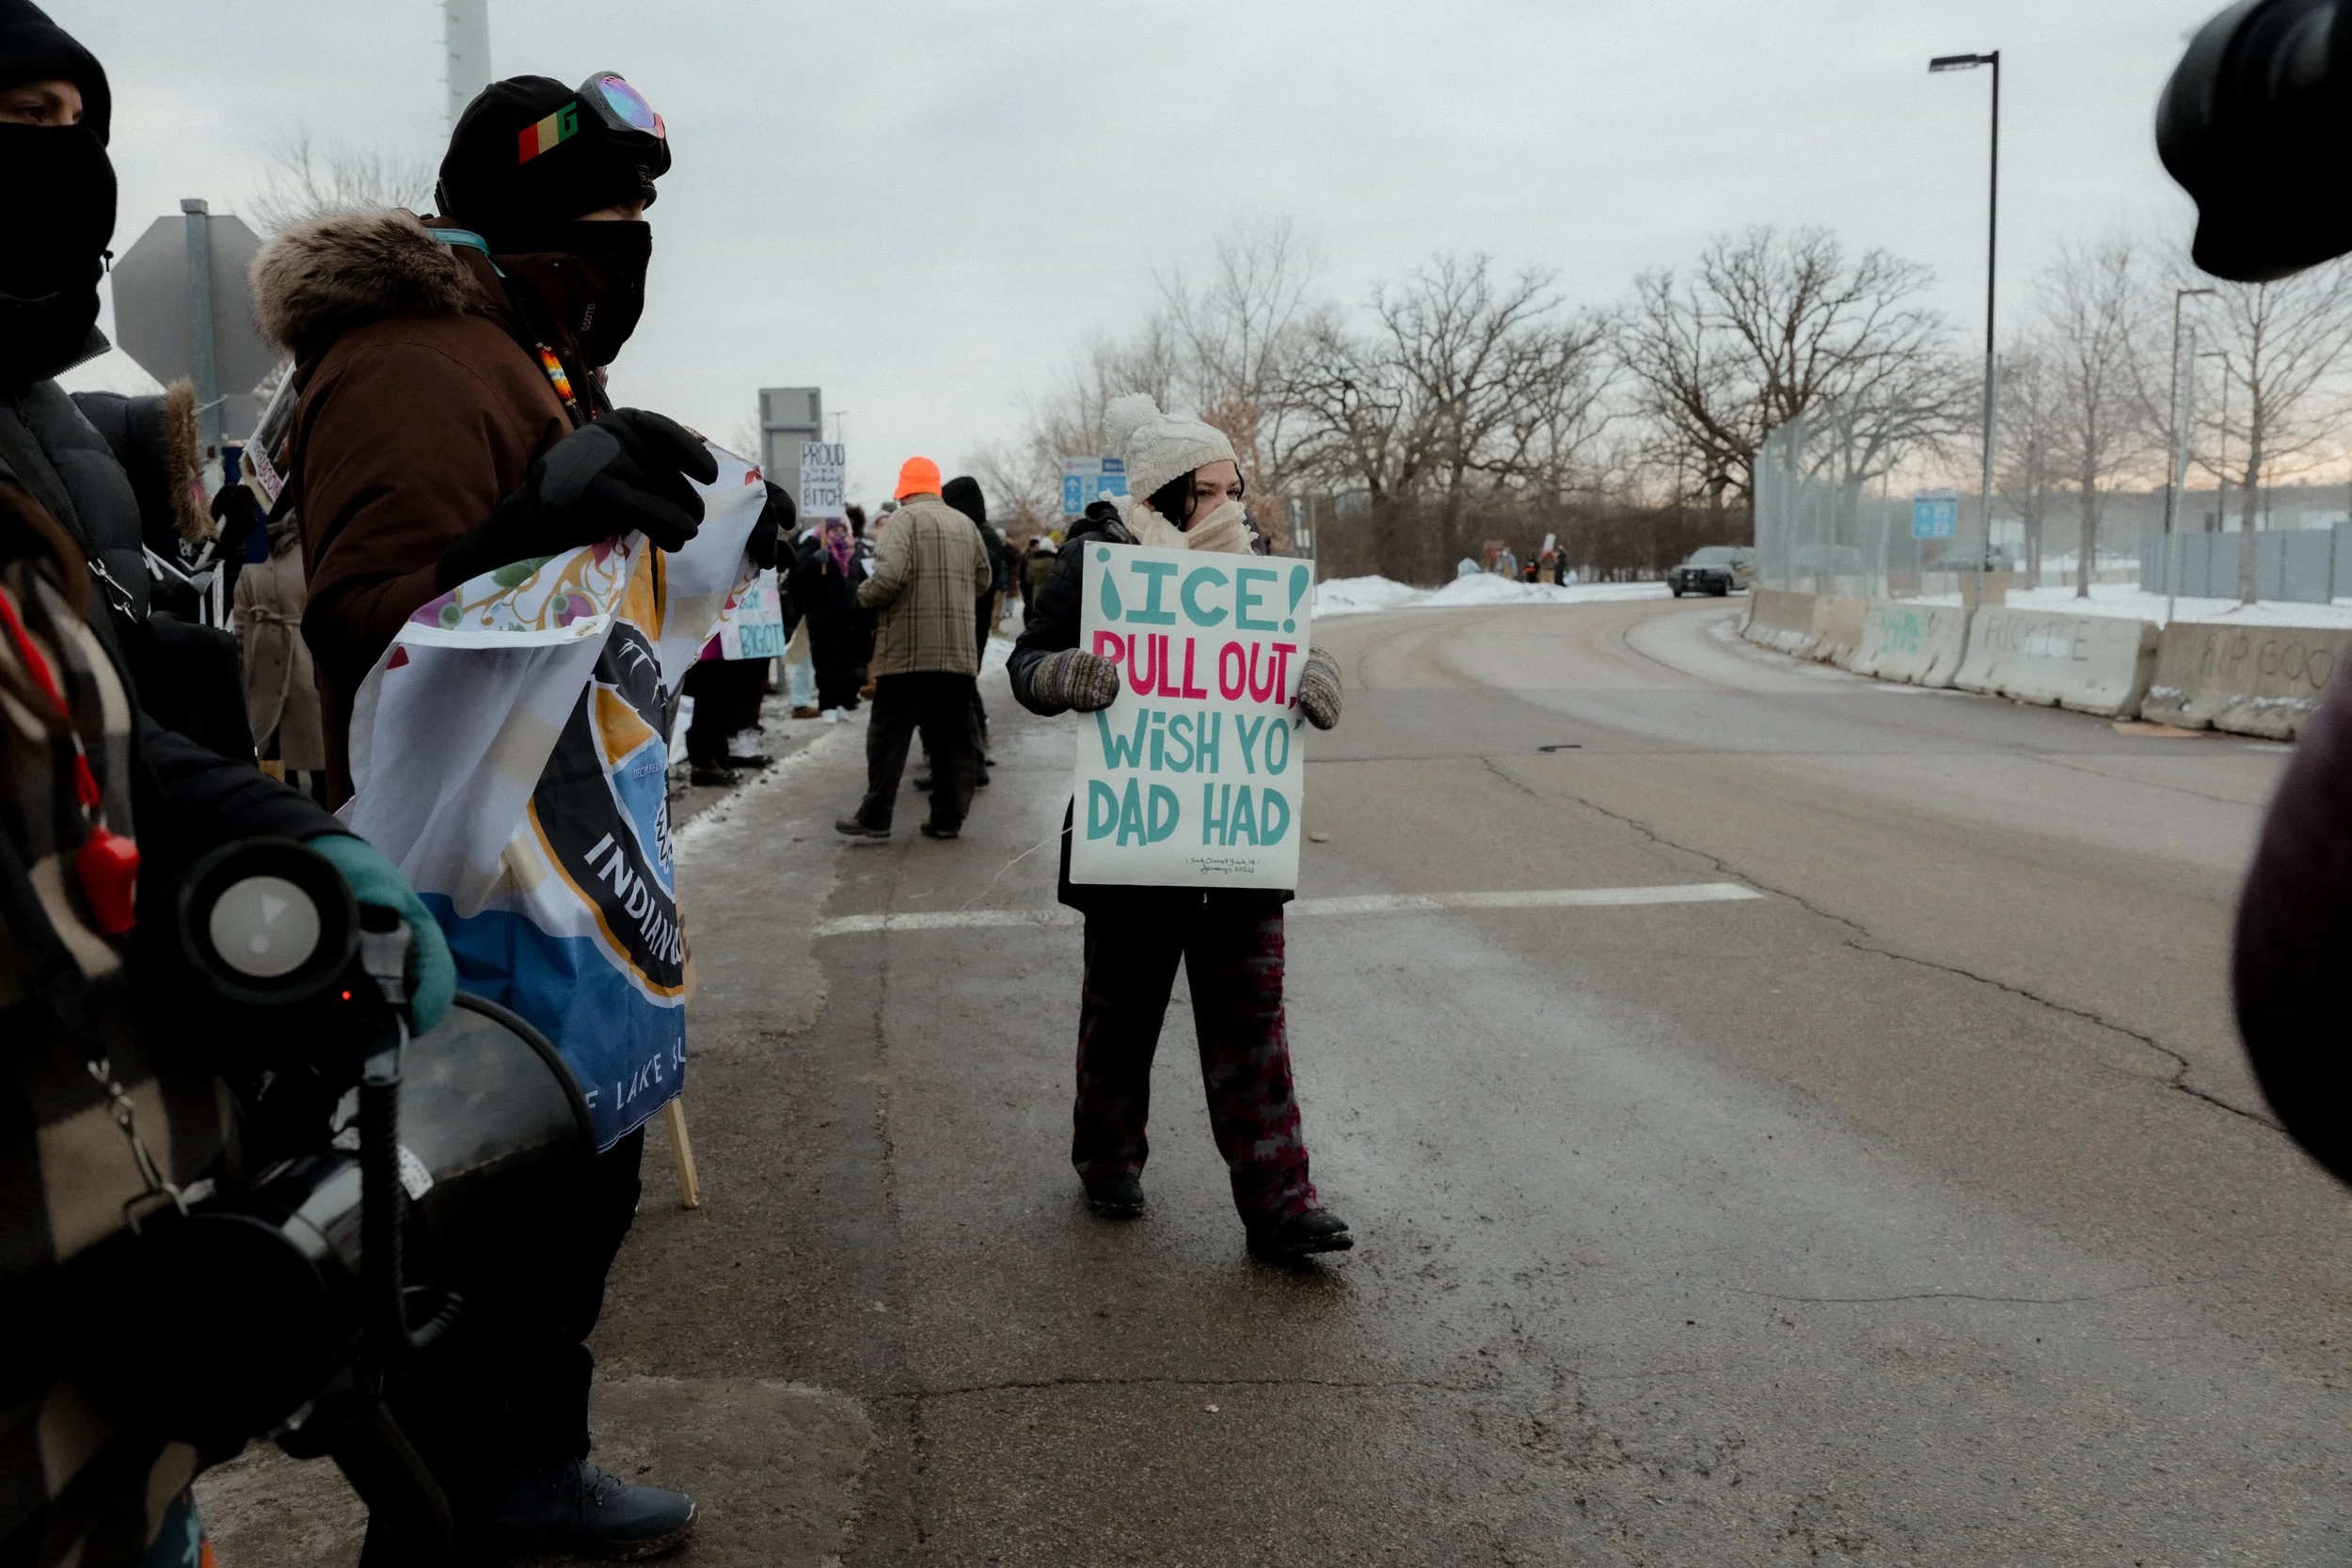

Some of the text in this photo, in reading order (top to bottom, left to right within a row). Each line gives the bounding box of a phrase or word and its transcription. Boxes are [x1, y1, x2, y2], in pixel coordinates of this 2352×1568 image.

[802, 443, 845, 467] PROUD
[1092, 630, 1207, 700] PULL
[1087, 777, 1291, 847] DAD HAD
[616, 1052, 662, 1112] LAKE
